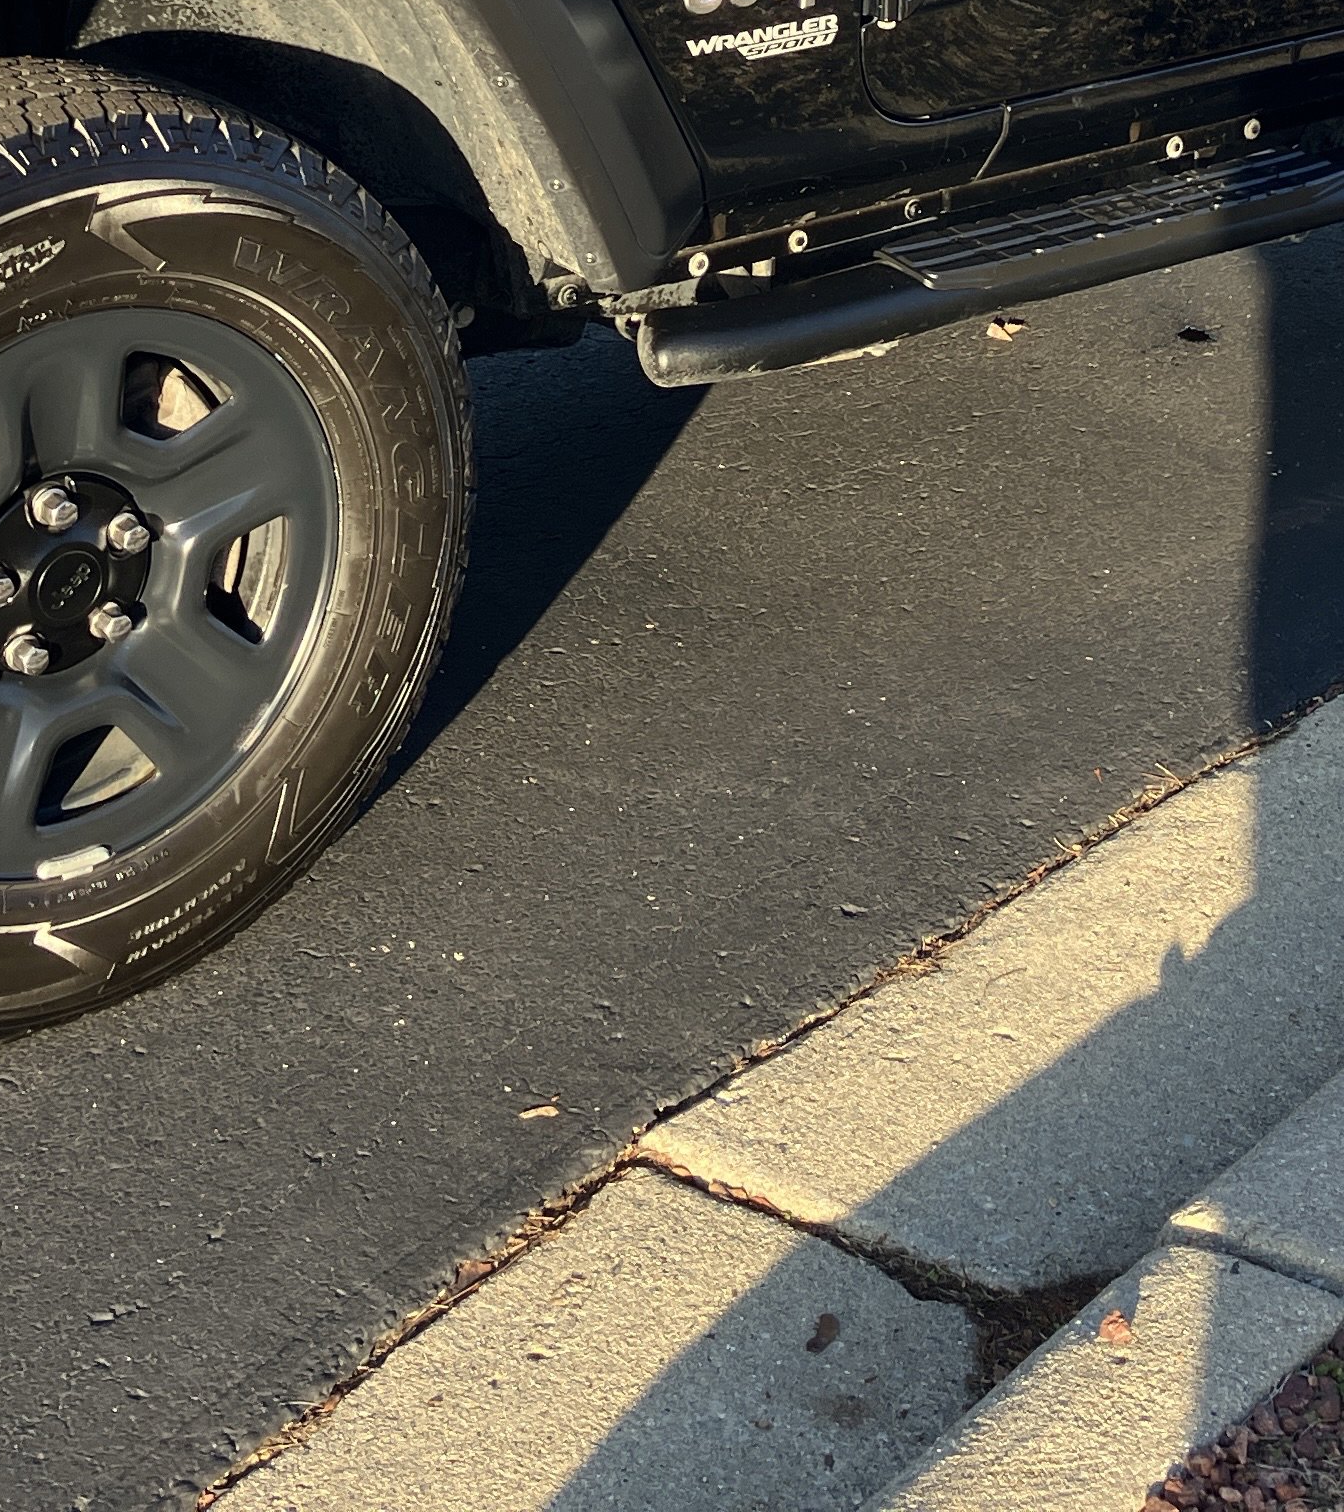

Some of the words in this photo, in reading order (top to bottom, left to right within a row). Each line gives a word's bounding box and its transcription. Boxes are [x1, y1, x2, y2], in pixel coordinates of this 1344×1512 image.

[685, 13, 839, 57] WRANGLER
[744, 32, 834, 56] SPORT
[233, 235, 438, 718] WRANGLER
[51, 563, 91, 610] Jeep
